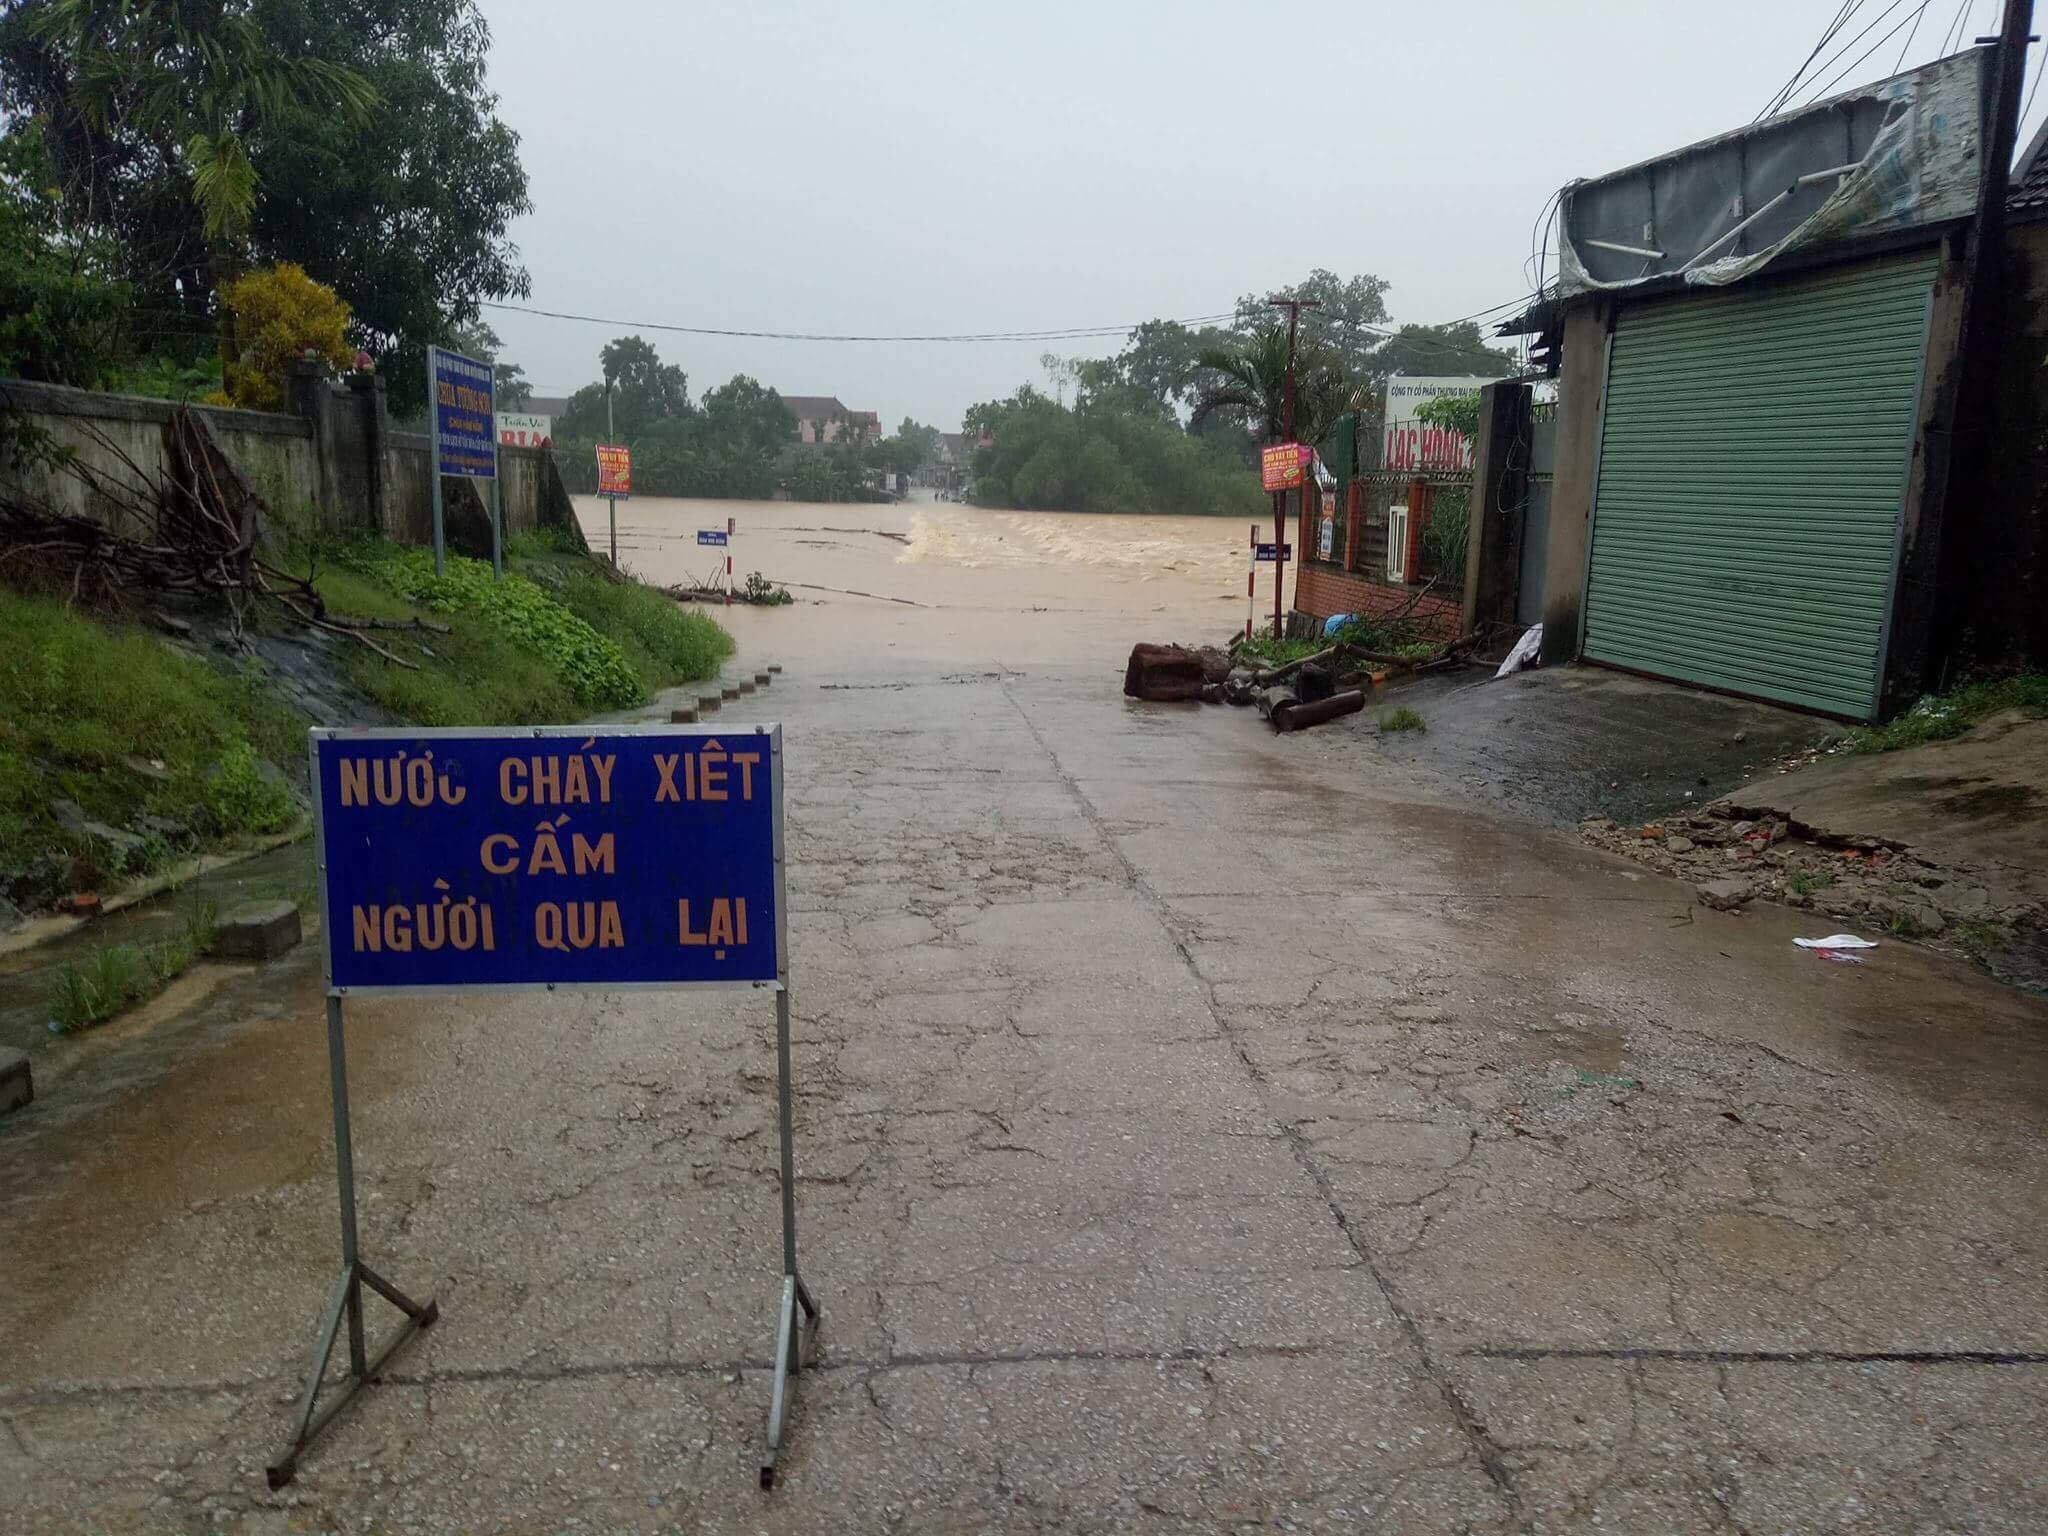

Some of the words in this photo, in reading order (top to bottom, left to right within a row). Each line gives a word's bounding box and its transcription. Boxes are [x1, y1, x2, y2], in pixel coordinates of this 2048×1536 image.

[480, 813, 615, 876] CẤM
[535, 901, 625, 953] QUA
[679, 897, 748, 960] LẠI
